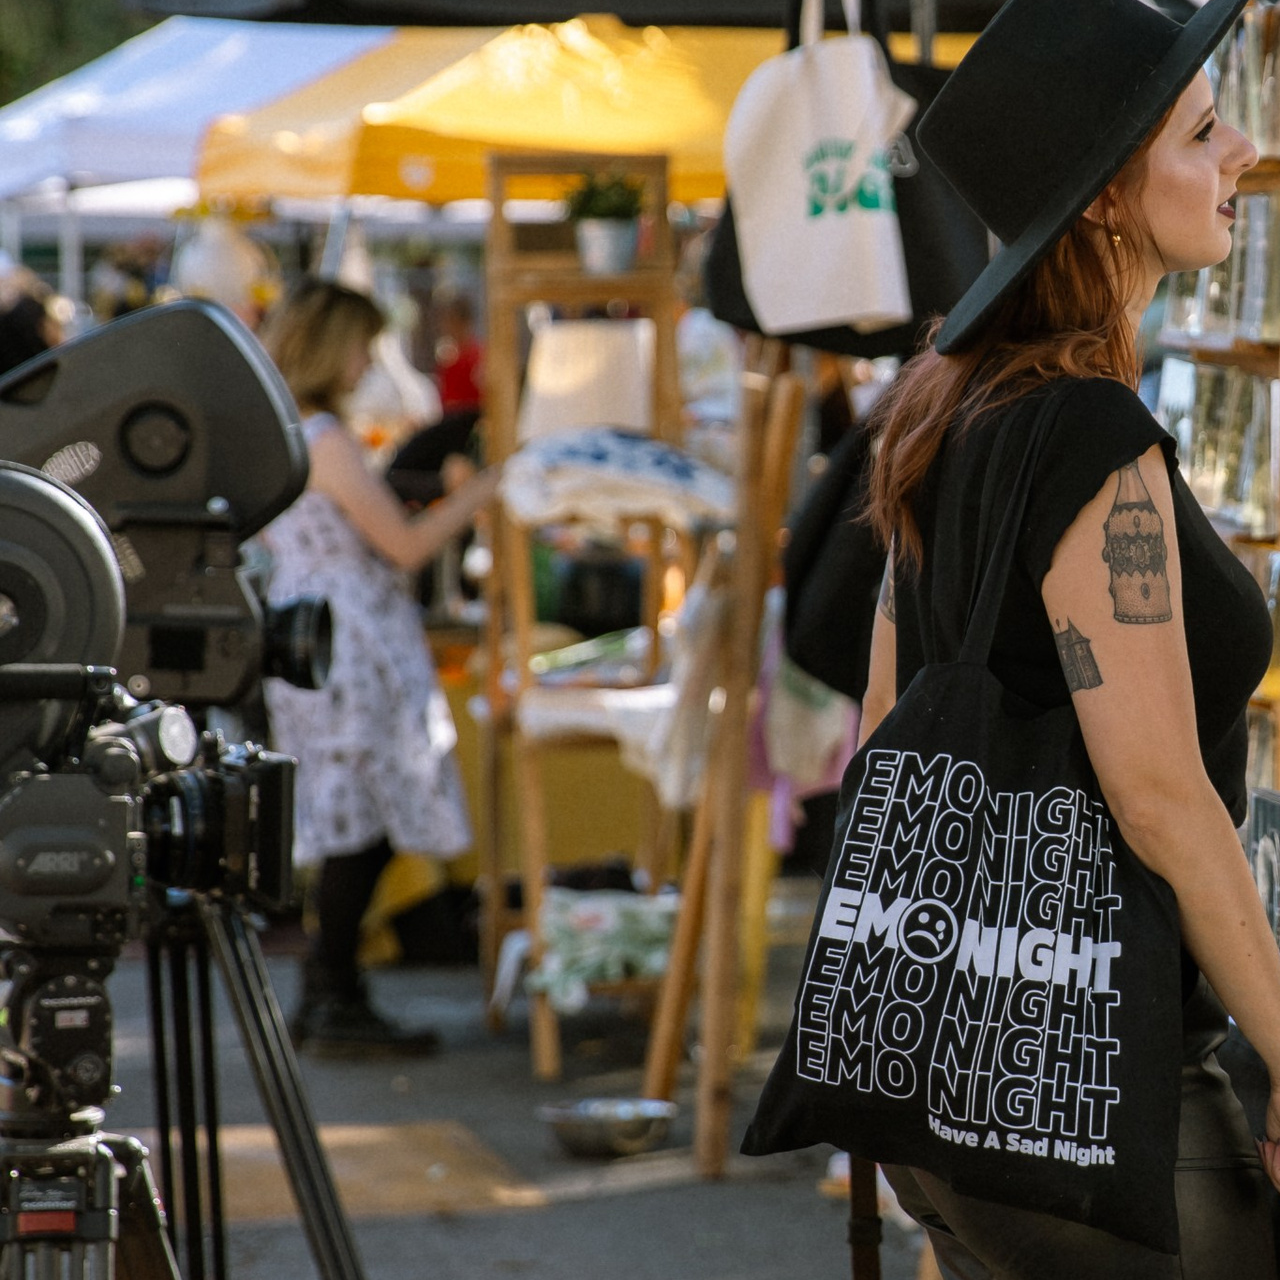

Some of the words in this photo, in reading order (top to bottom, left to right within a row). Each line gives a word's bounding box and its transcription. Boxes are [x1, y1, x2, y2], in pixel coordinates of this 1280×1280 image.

[859, 749, 985, 813] EMO
[844, 795, 975, 863] EMO
[833, 842, 964, 908] EMO
[966, 870, 1122, 943] NIGHT
[806, 935, 938, 1006] EMO
[943, 969, 1121, 1039] NIGHT
[955, 919, 1122, 993] NIGHT
[797, 980, 925, 1055] EMO
[931, 1014, 1121, 1089] NIGHT
[796, 1028, 917, 1099] EMO
[927, 1062, 1121, 1140] NIGHT
[927, 1113, 979, 1148] Have
[983, 1130, 1001, 1150] A
[1005, 1132, 1049, 1158] Sad
[1053, 1139, 1116, 1167] Night
